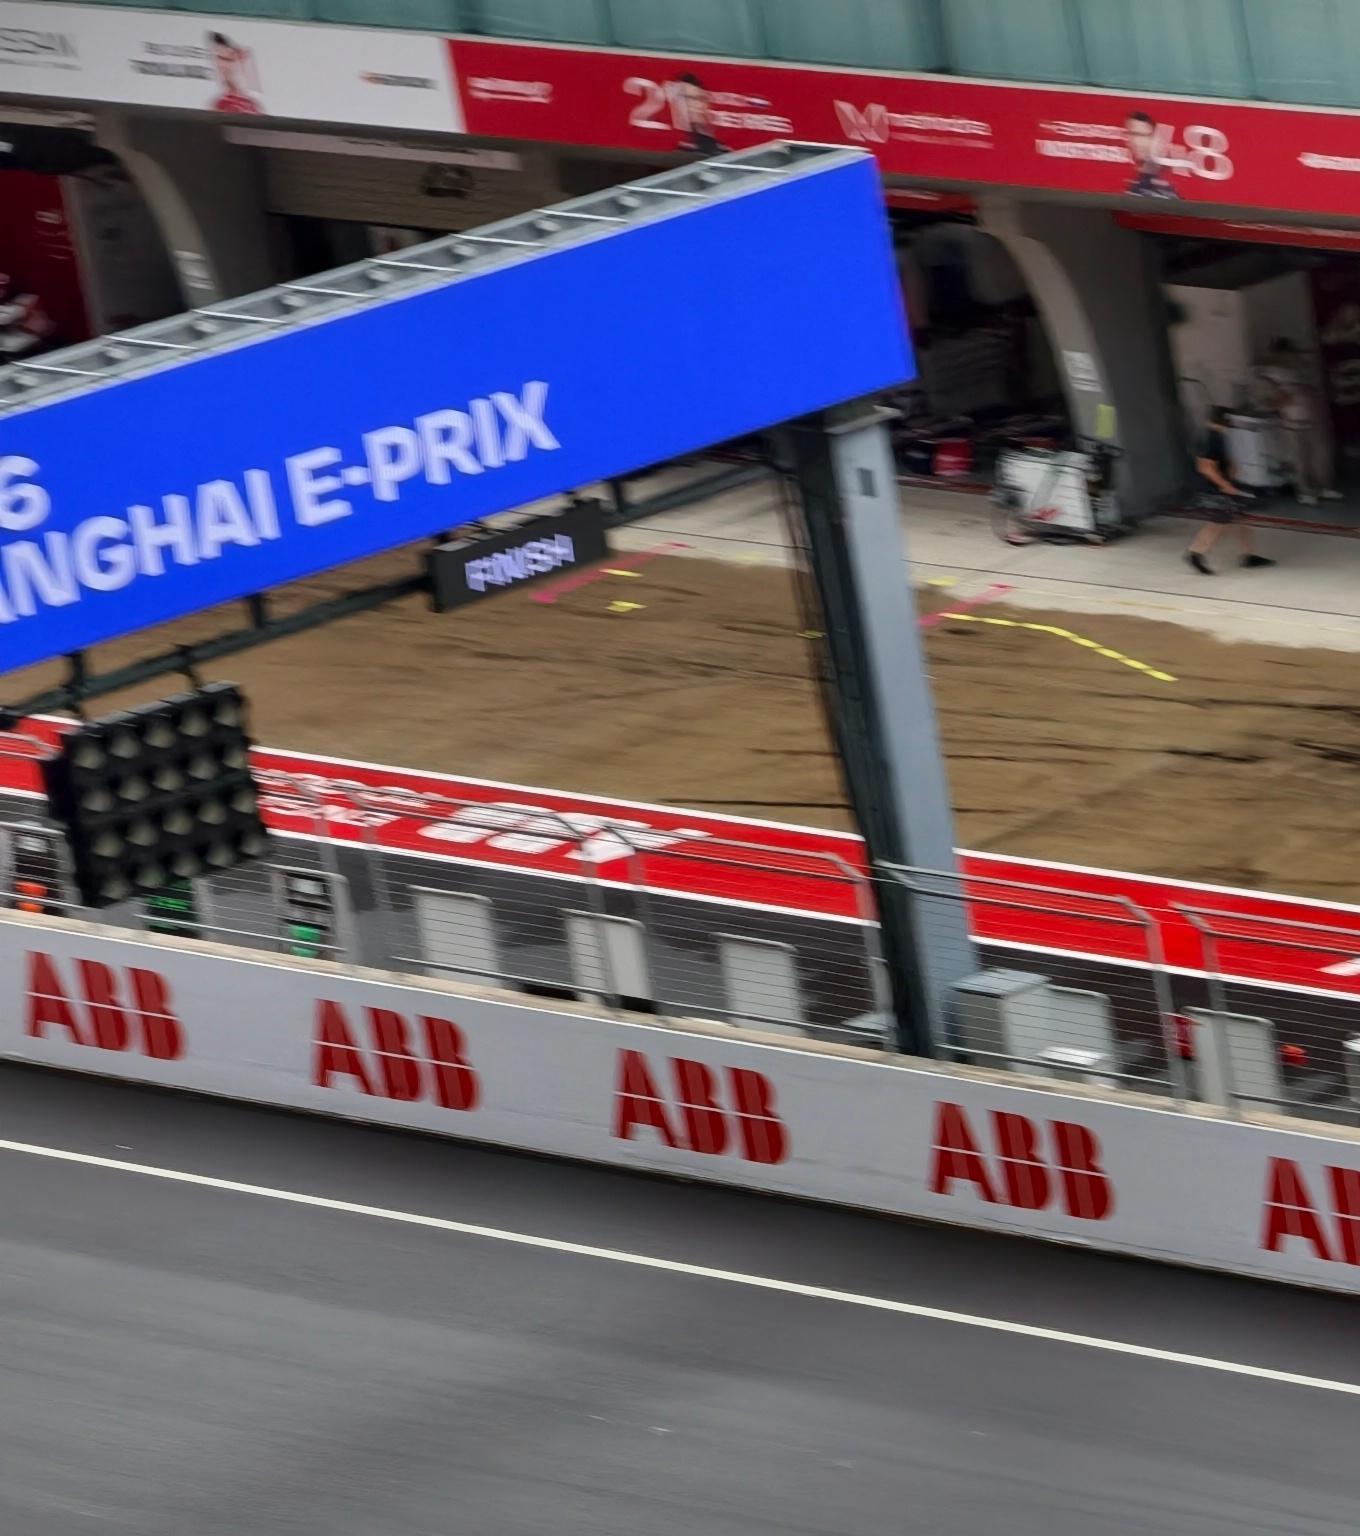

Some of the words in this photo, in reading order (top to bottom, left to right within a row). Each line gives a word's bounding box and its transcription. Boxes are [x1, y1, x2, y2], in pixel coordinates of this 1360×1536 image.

[1151, 123, 1235, 181] 48
[0, 455, 51, 531] 6
[0, 468, 281, 624] NGHAI
[285, 379, 562, 527] E-PRIX
[464, 533, 576, 592] FINISH
[27, 952, 185, 1059] ABB
[313, 1000, 479, 1110] ABB
[613, 1050, 786, 1164] ABB
[931, 1102, 1113, 1220] ABB
